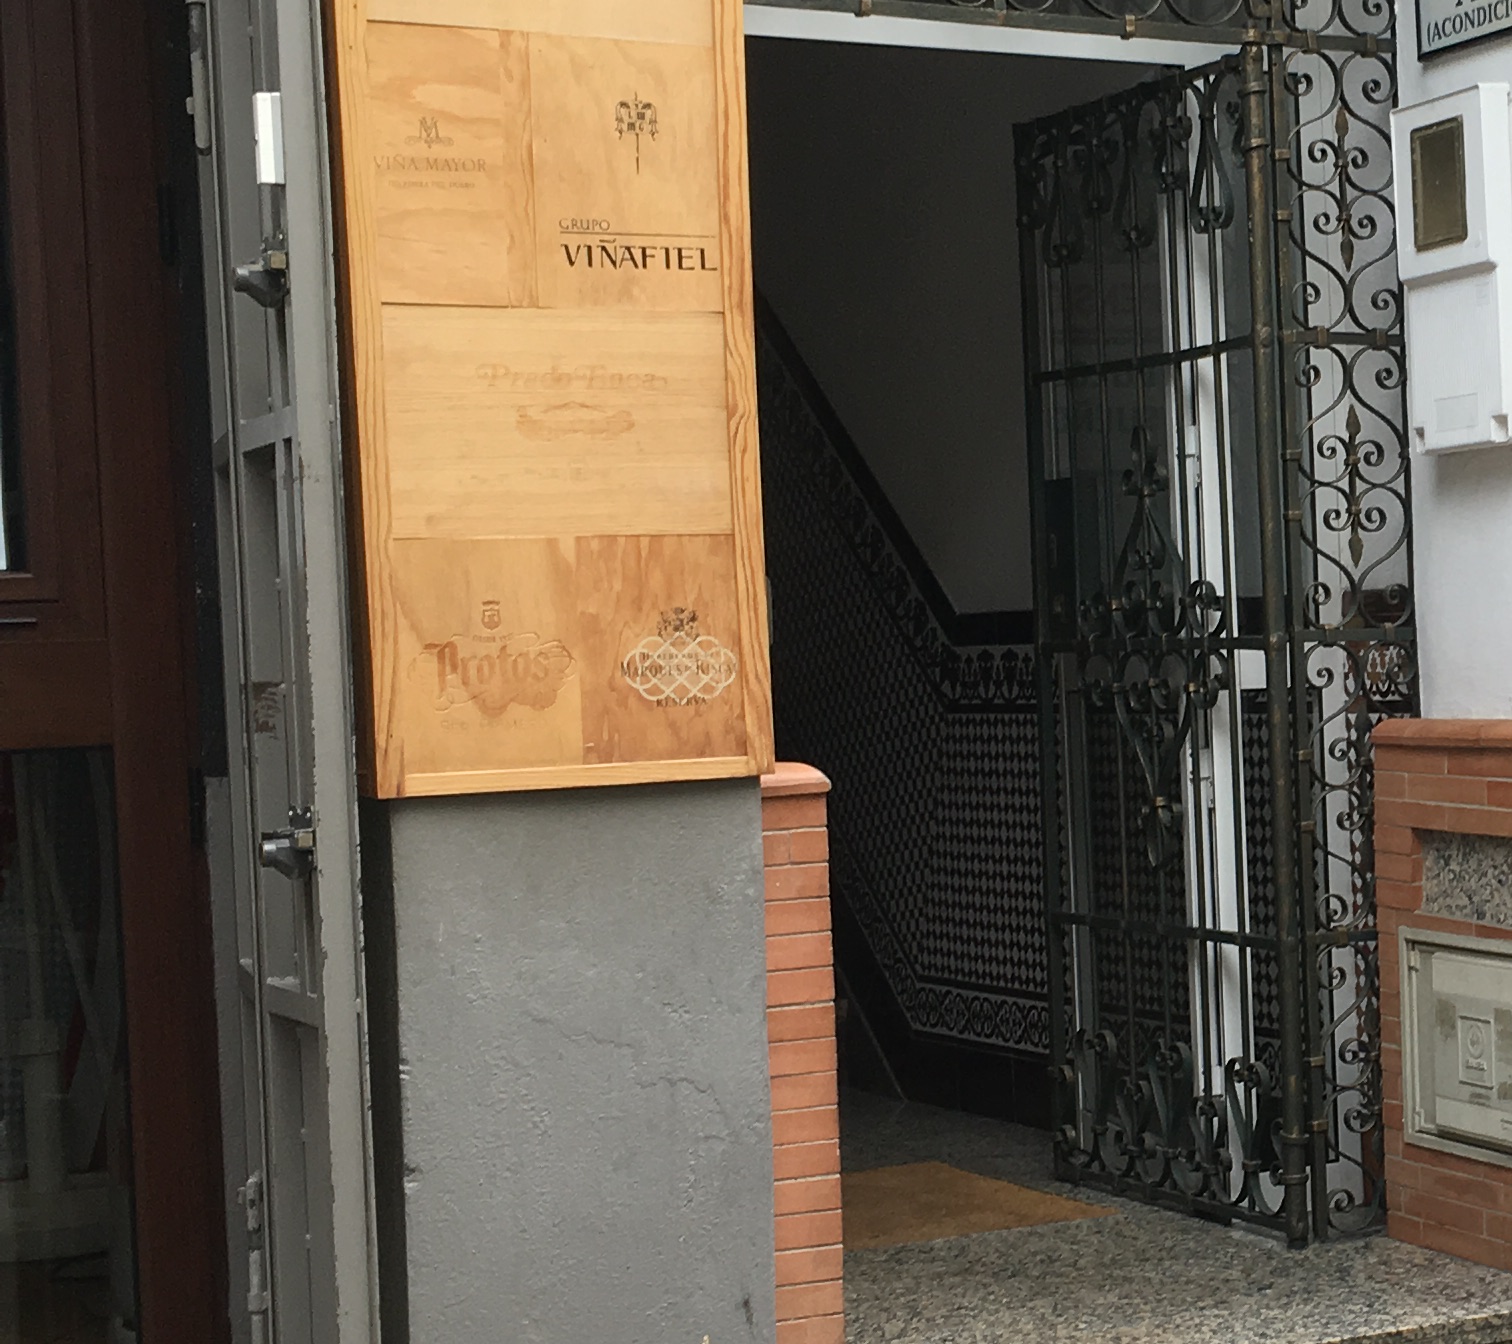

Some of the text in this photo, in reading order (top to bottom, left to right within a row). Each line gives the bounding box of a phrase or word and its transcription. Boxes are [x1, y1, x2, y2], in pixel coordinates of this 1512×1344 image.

[424, 156, 487, 173] MAYOR
[558, 217, 611, 232] GRUPO
[560, 237, 719, 272] VIÑAFIEL
